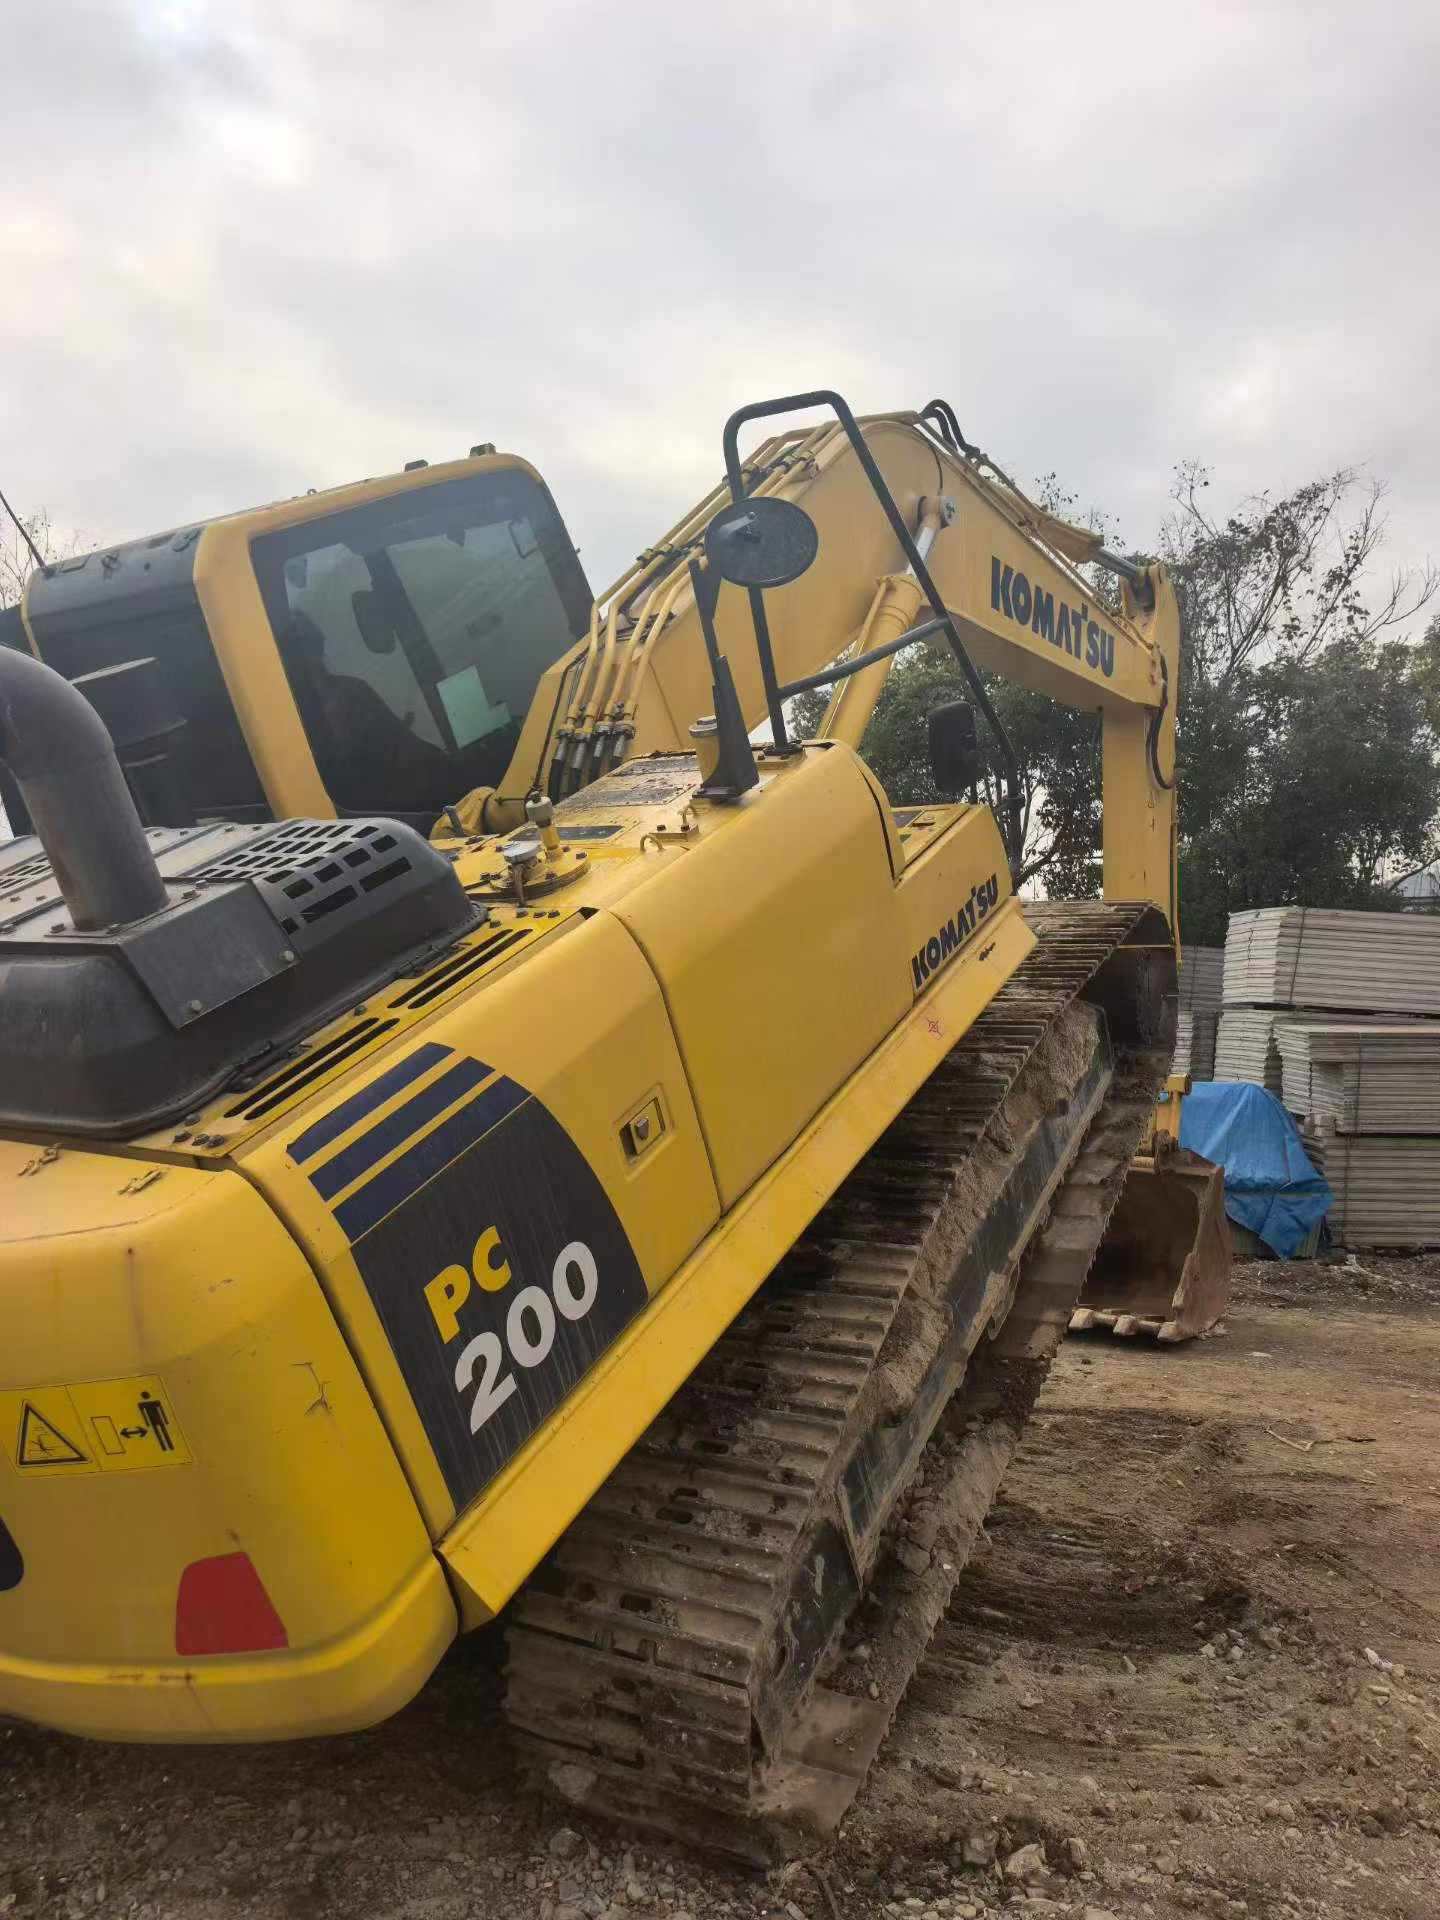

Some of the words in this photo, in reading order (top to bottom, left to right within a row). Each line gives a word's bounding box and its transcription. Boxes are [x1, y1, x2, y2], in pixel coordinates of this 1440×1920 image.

[991, 555, 1115, 677] KOMATSU
[911, 873, 998, 989] KOMATSU
[423, 1225, 512, 1345] PC
[455, 1241, 598, 1435] 200
